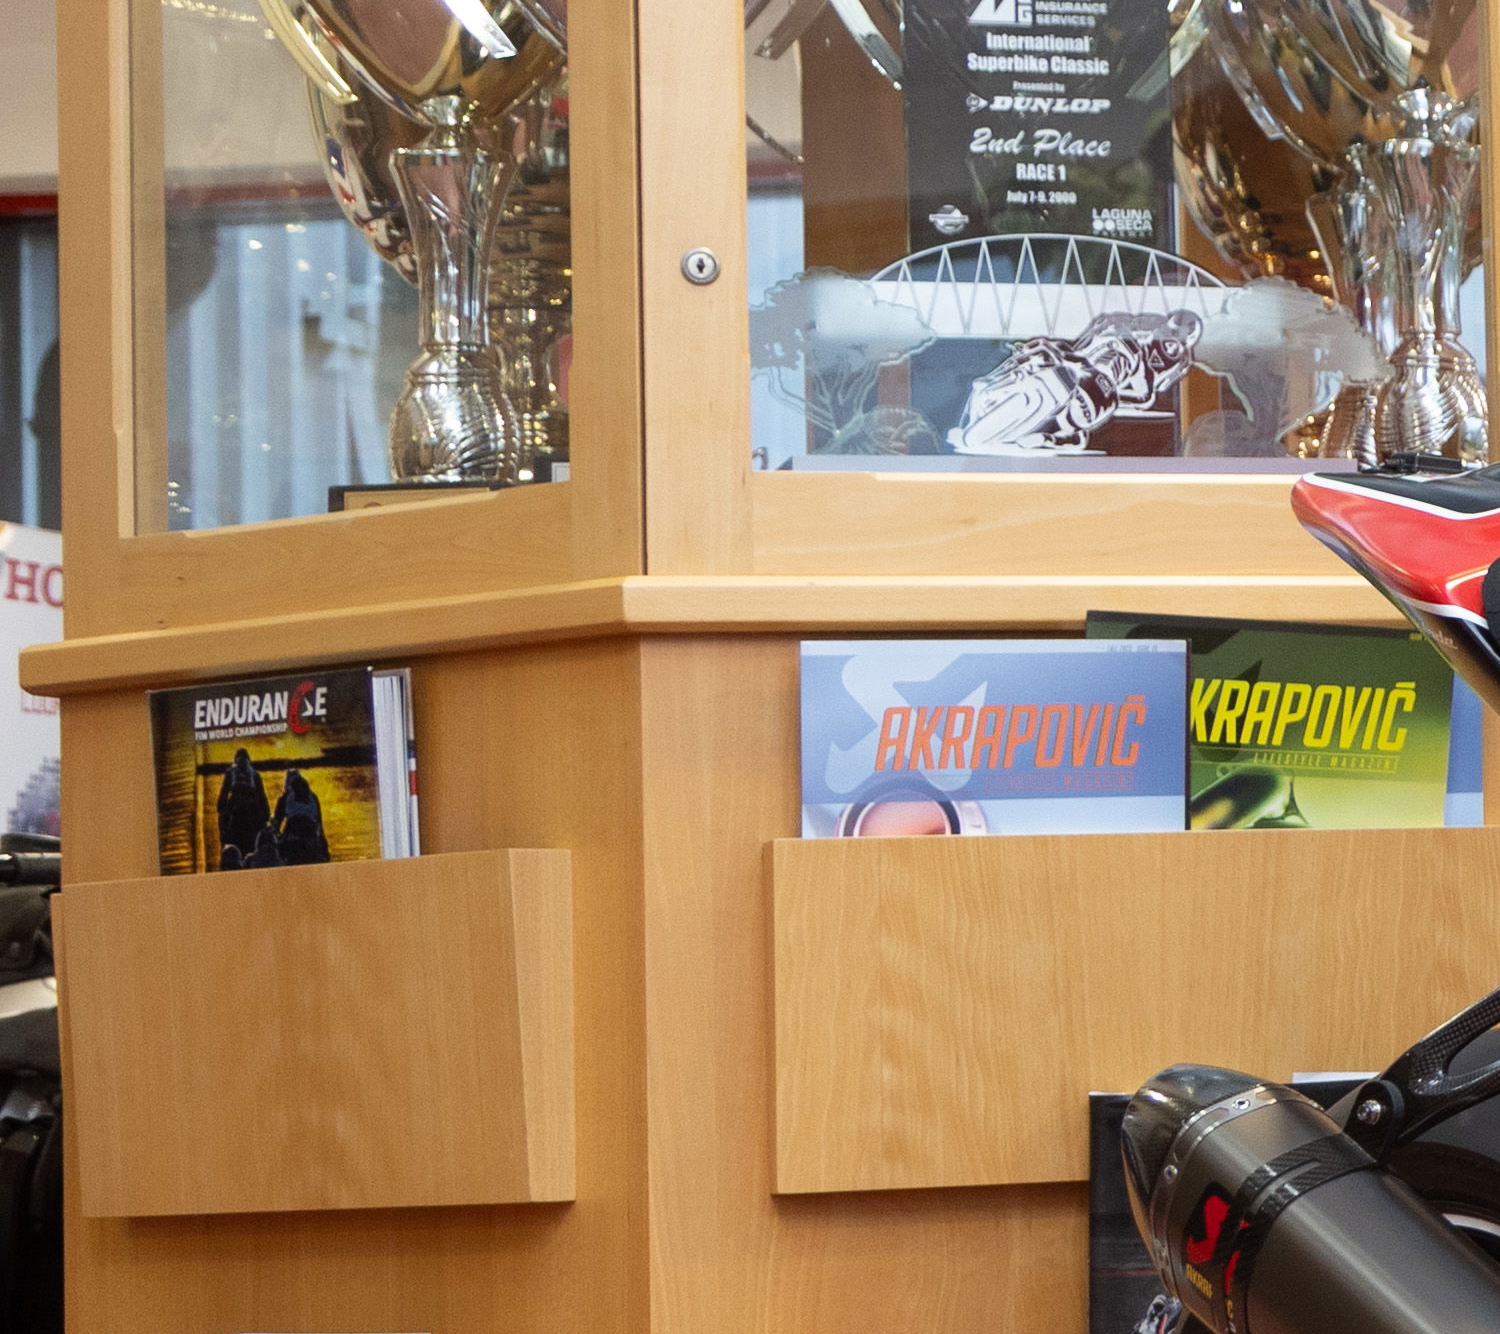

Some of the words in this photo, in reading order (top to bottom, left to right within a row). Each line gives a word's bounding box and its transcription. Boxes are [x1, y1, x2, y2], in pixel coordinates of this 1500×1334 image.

[1035, 1, 1108, 15] INSURANCE
[1035, 14, 1096, 27] SERVICES
[986, 31, 1090, 53] International
[967, 52, 1048, 75] Superbike
[1051, 55, 1110, 75] Classic
[989, 95, 1111, 114] DUNLOP
[969, 126, 1025, 154] 2nd
[1033, 128, 1112, 157] Place
[1016, 163, 1058, 181] RACE
[1059, 164, 1067, 181] 1
[1006, 190, 1027, 205] July
[1092, 208, 1152, 221] LAGUNA
[1115, 220, 1152, 231] SECA
[1190, 678, 1417, 752] KRAPOVIČ
[208, 728, 234, 740] WORLD
[235, 723, 288, 737] CHAMPIONSHIP
[1253, 751, 1323, 767] LIFESTYLE
